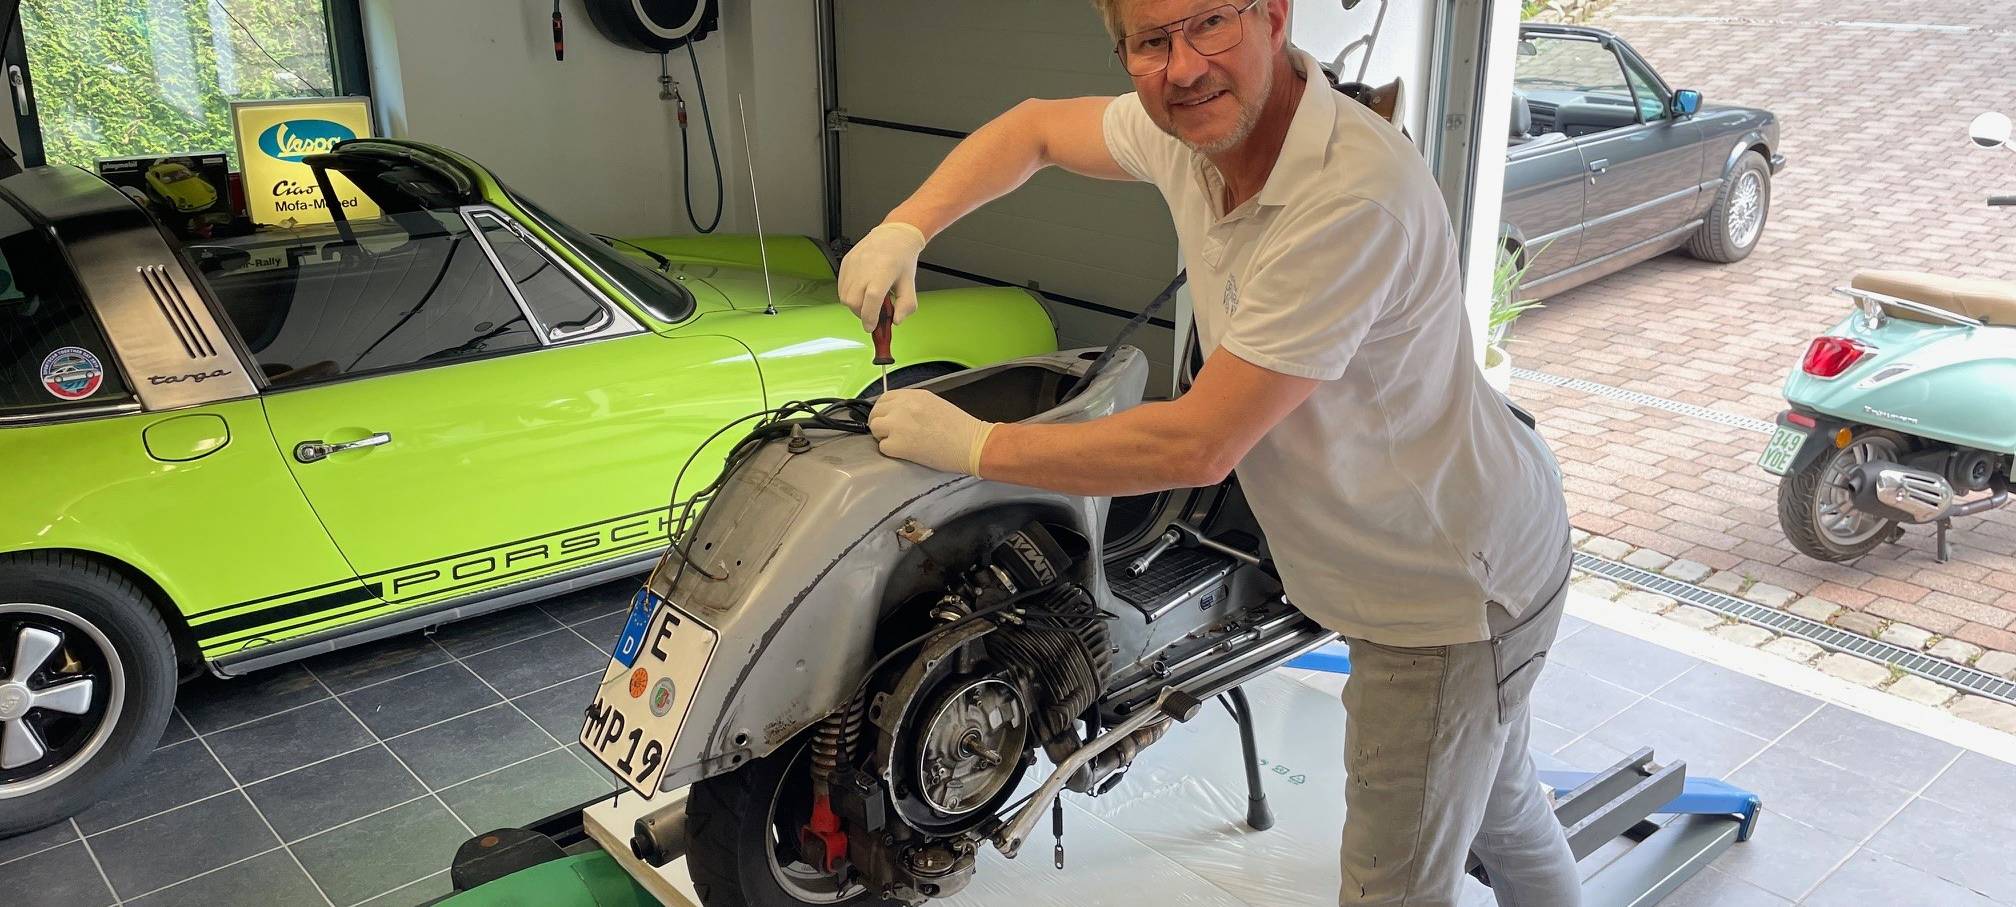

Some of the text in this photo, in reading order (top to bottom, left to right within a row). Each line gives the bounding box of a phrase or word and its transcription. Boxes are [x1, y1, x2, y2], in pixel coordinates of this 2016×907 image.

[272, 180, 319, 196] Ciao
[275, 197, 358, 212] Mofa-Med
[147, 369, 232, 385] targa
[1772, 430, 1801, 451] 349
[393, 509, 696, 595] PORSCH
[622, 636, 635, 655] D
[650, 612, 681, 663] E
